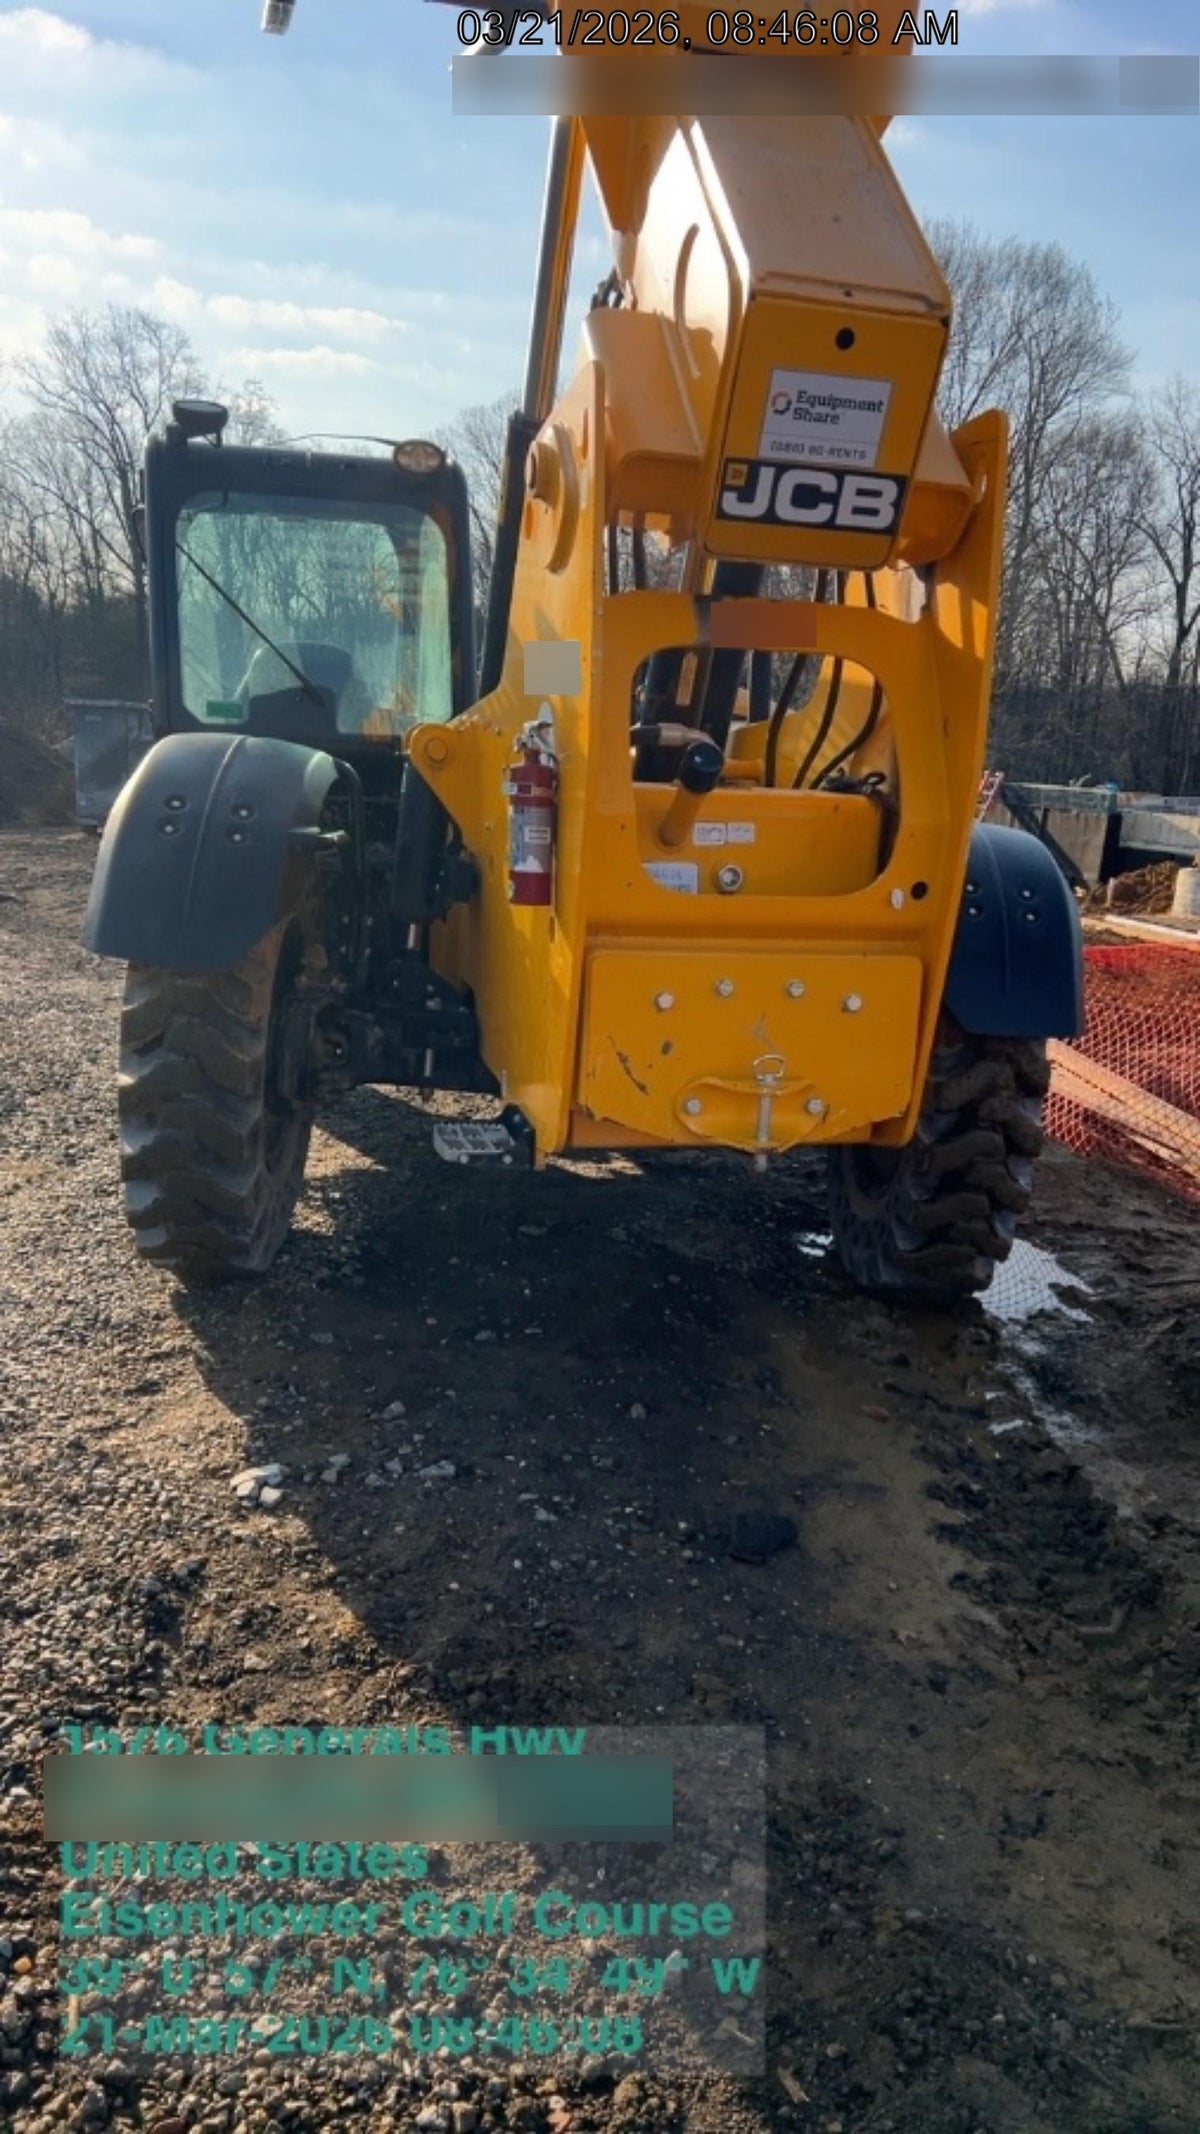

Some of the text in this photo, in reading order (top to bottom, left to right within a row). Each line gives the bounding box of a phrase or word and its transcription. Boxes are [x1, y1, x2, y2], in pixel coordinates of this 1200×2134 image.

[796, 390, 885, 414] Equipment
[792, 407, 841, 425] Share
[721, 465, 899, 529] JCB
